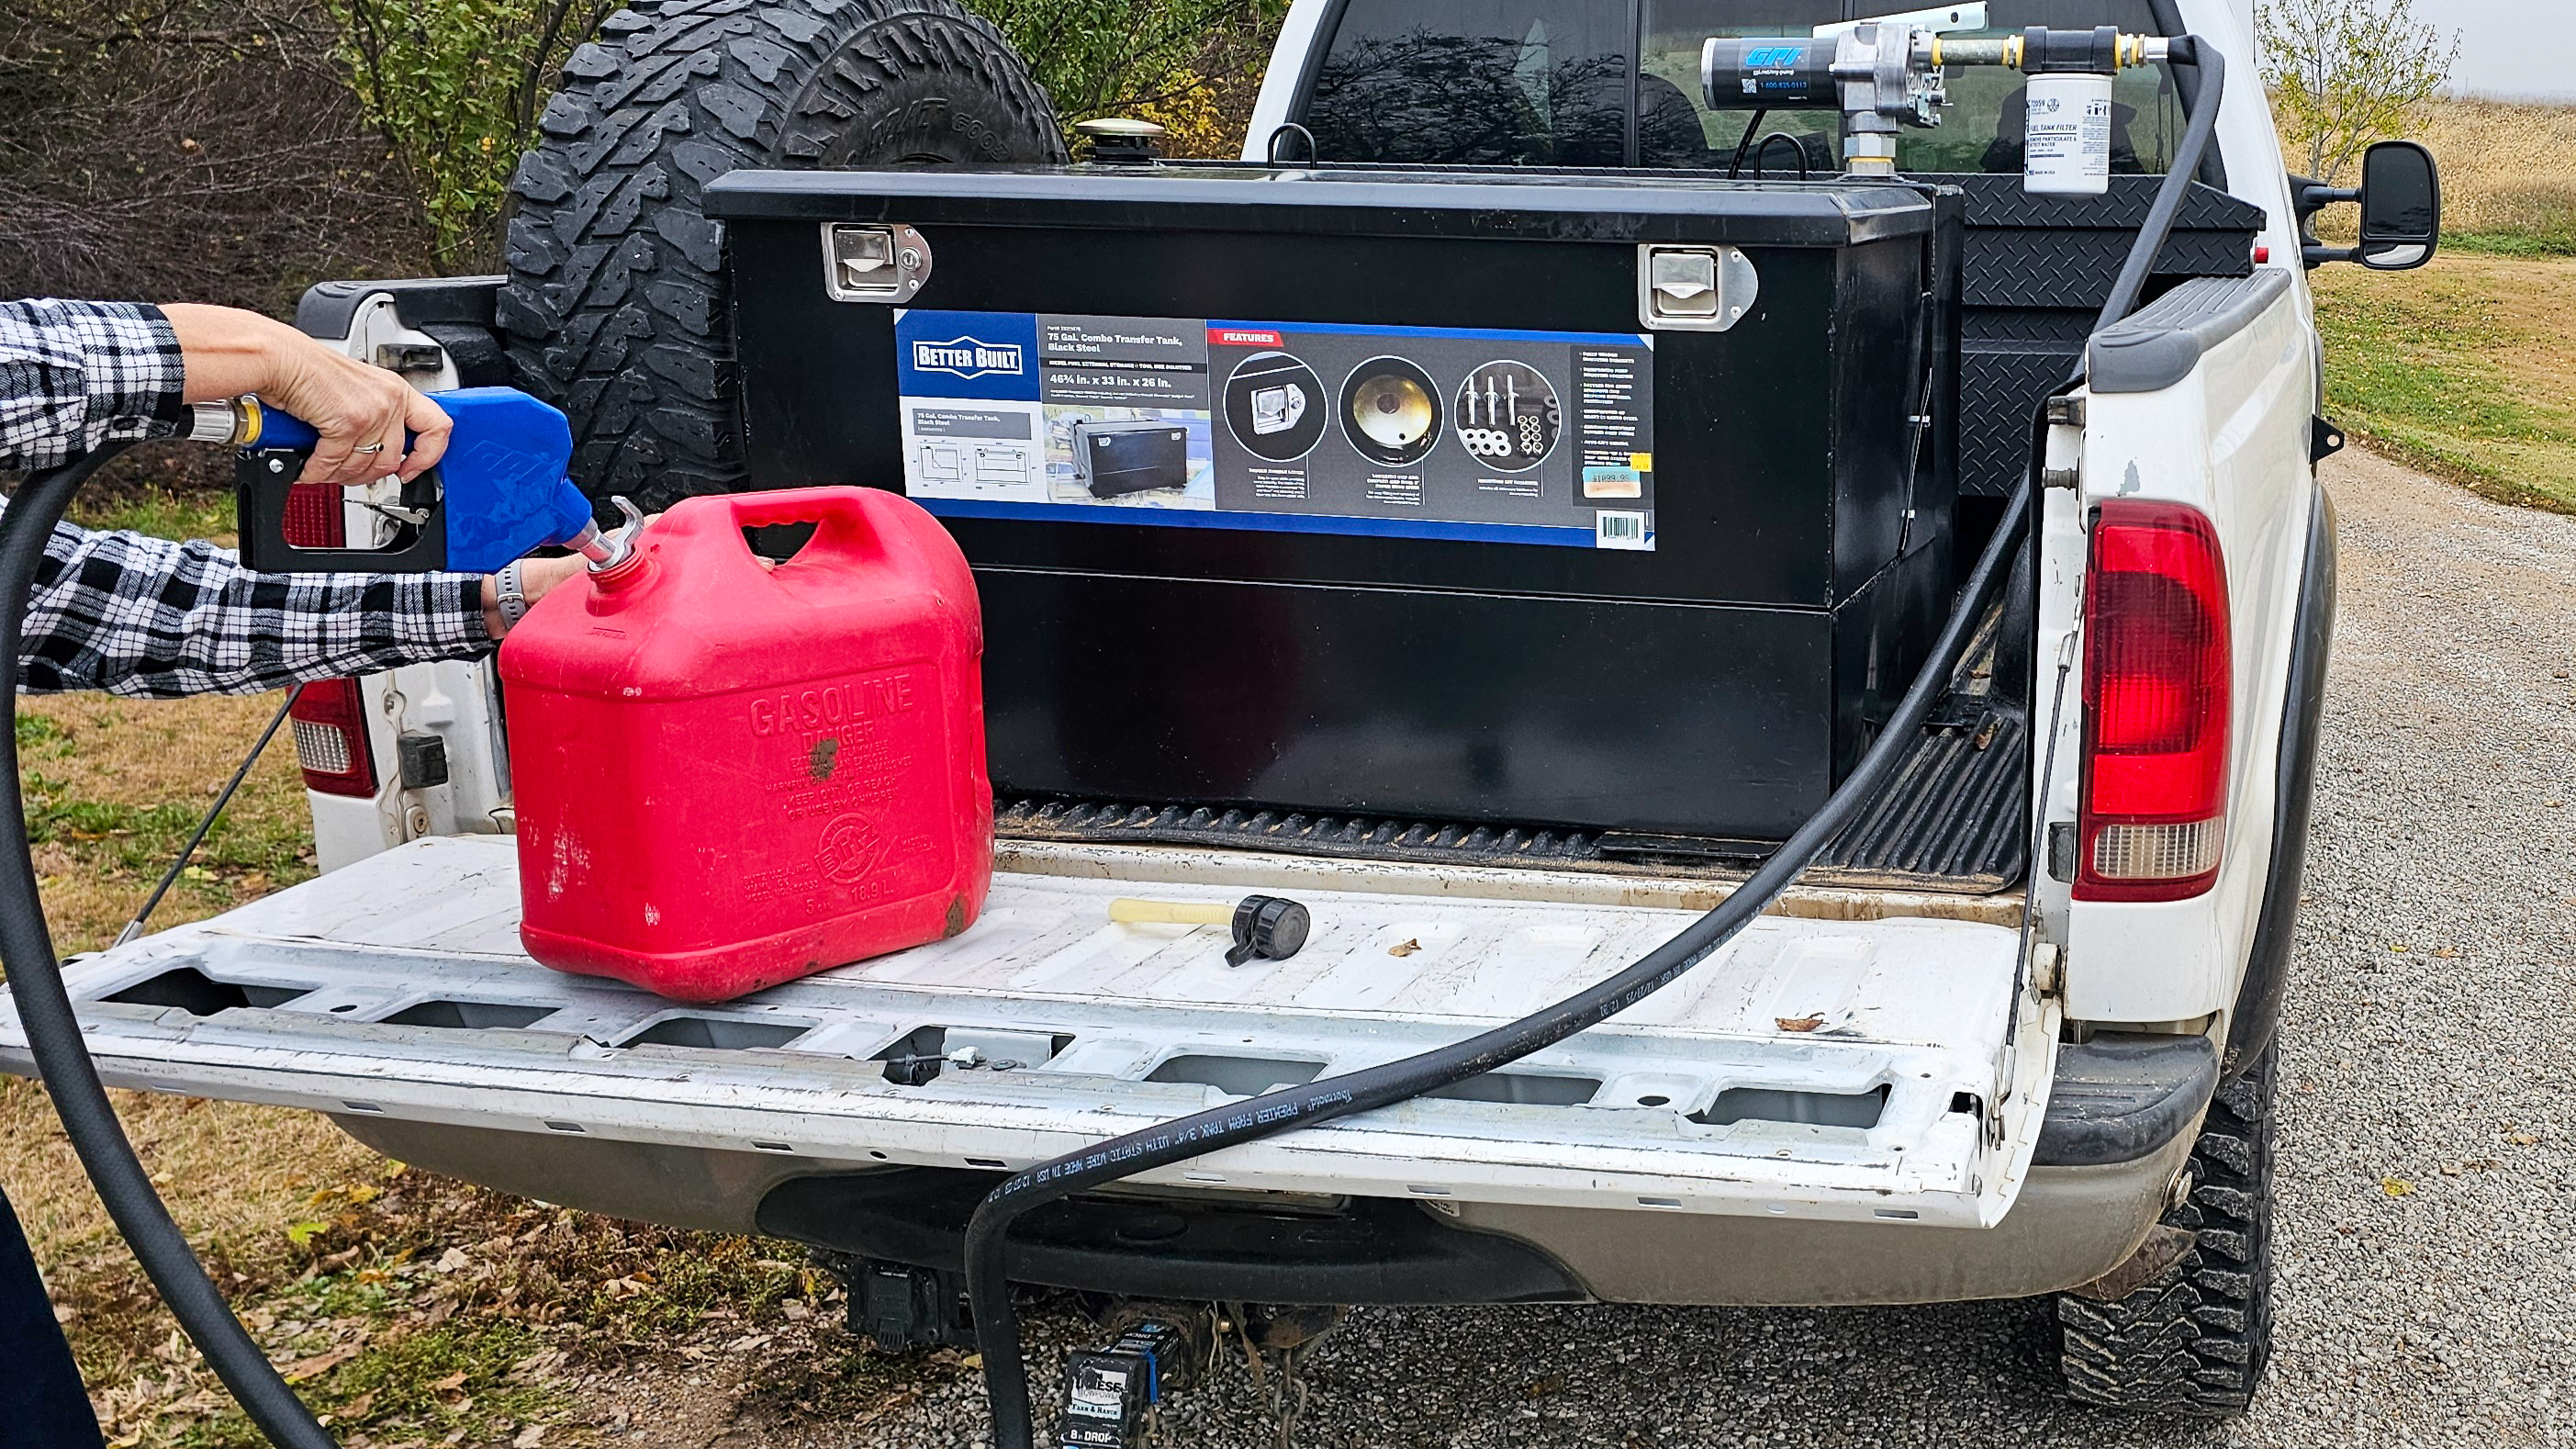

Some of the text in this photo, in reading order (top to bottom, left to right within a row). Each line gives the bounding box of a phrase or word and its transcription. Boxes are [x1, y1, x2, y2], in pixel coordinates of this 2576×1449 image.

[1746, 47, 1803, 66] GPI
[1047, 332, 1059, 341] 75
[1081, 333, 1114, 343] Combo
[1114, 334, 1154, 344] Transfer
[1155, 336, 1183, 347] Tank,
[1223, 332, 1274, 343] FEATURES
[919, 345, 973, 367] BETTER
[1047, 343, 1101, 353] Black Steel
[1076, 375, 1091, 385] in.
[1092, 376, 1100, 386] x
[1101, 376, 1115, 386] 33
[1116, 376, 1131, 387] in.
[1132, 377, 1140, 388] x
[1141, 377, 1156, 388] 26
[1157, 377, 1172, 388] in.
[750, 674, 914, 737] GASOLINE
[851, 882, 879, 904] 18.9
[1258, 1102, 1299, 1124] PREMIER
[1228, 1112, 1253, 1131] FARM
[1201, 1124, 1225, 1139] TANK
[1146, 1135, 1170, 1151] WITH
[1110, 1141, 1142, 1163] STATIC
[1064, 1161, 1083, 1175] MADE
[1086, 1153, 1107, 1170] WIRE
[1036, 1167, 1050, 1184] USA
[1051, 1165, 1061, 1178] IN
[1070, 1430, 1079, 1440] 8
[1084, 1431, 1112, 1443] DROP
